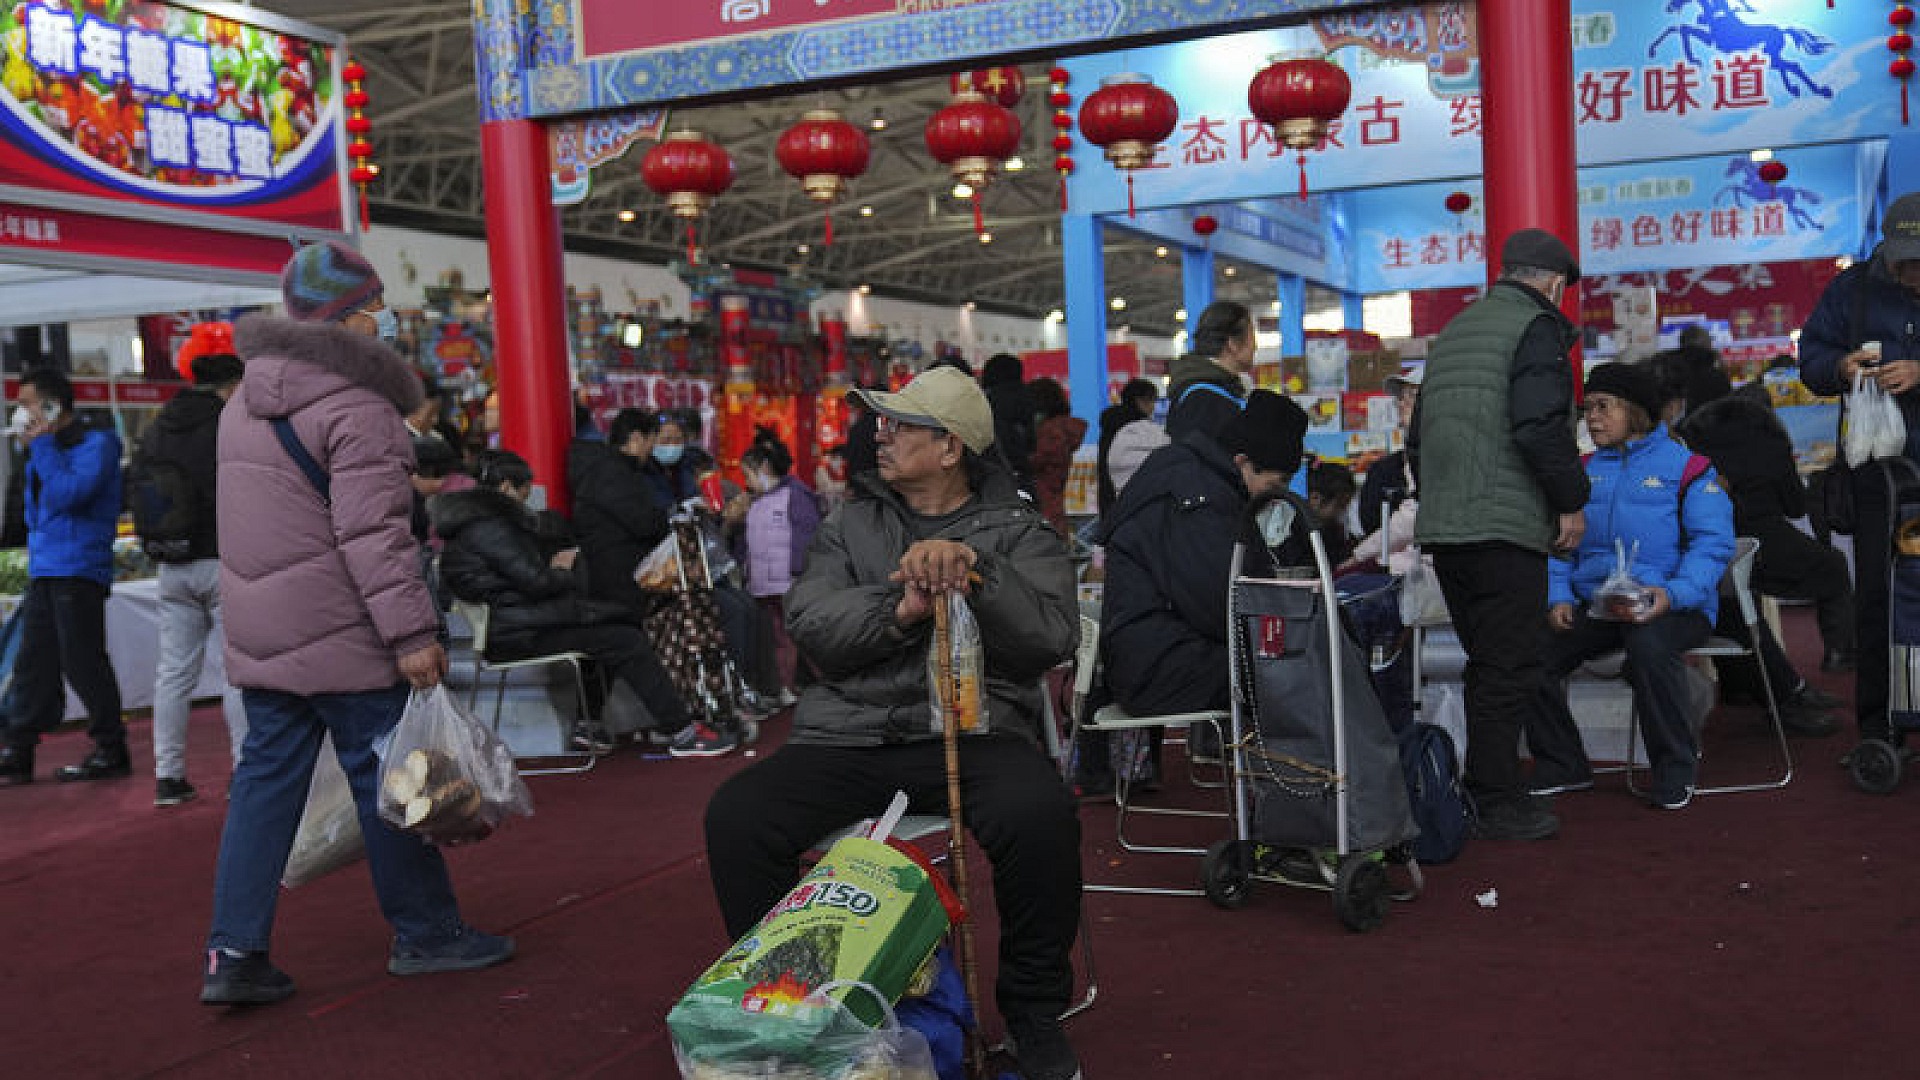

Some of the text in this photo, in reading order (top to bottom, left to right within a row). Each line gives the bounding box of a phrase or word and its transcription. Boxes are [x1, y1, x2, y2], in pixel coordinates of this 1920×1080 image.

[1578, 53, 1770, 124] 好味道
[0, 213, 60, 241] 年糖果
[1592, 204, 1784, 250] 绿色好味道
[812, 882, 880, 916] 150
